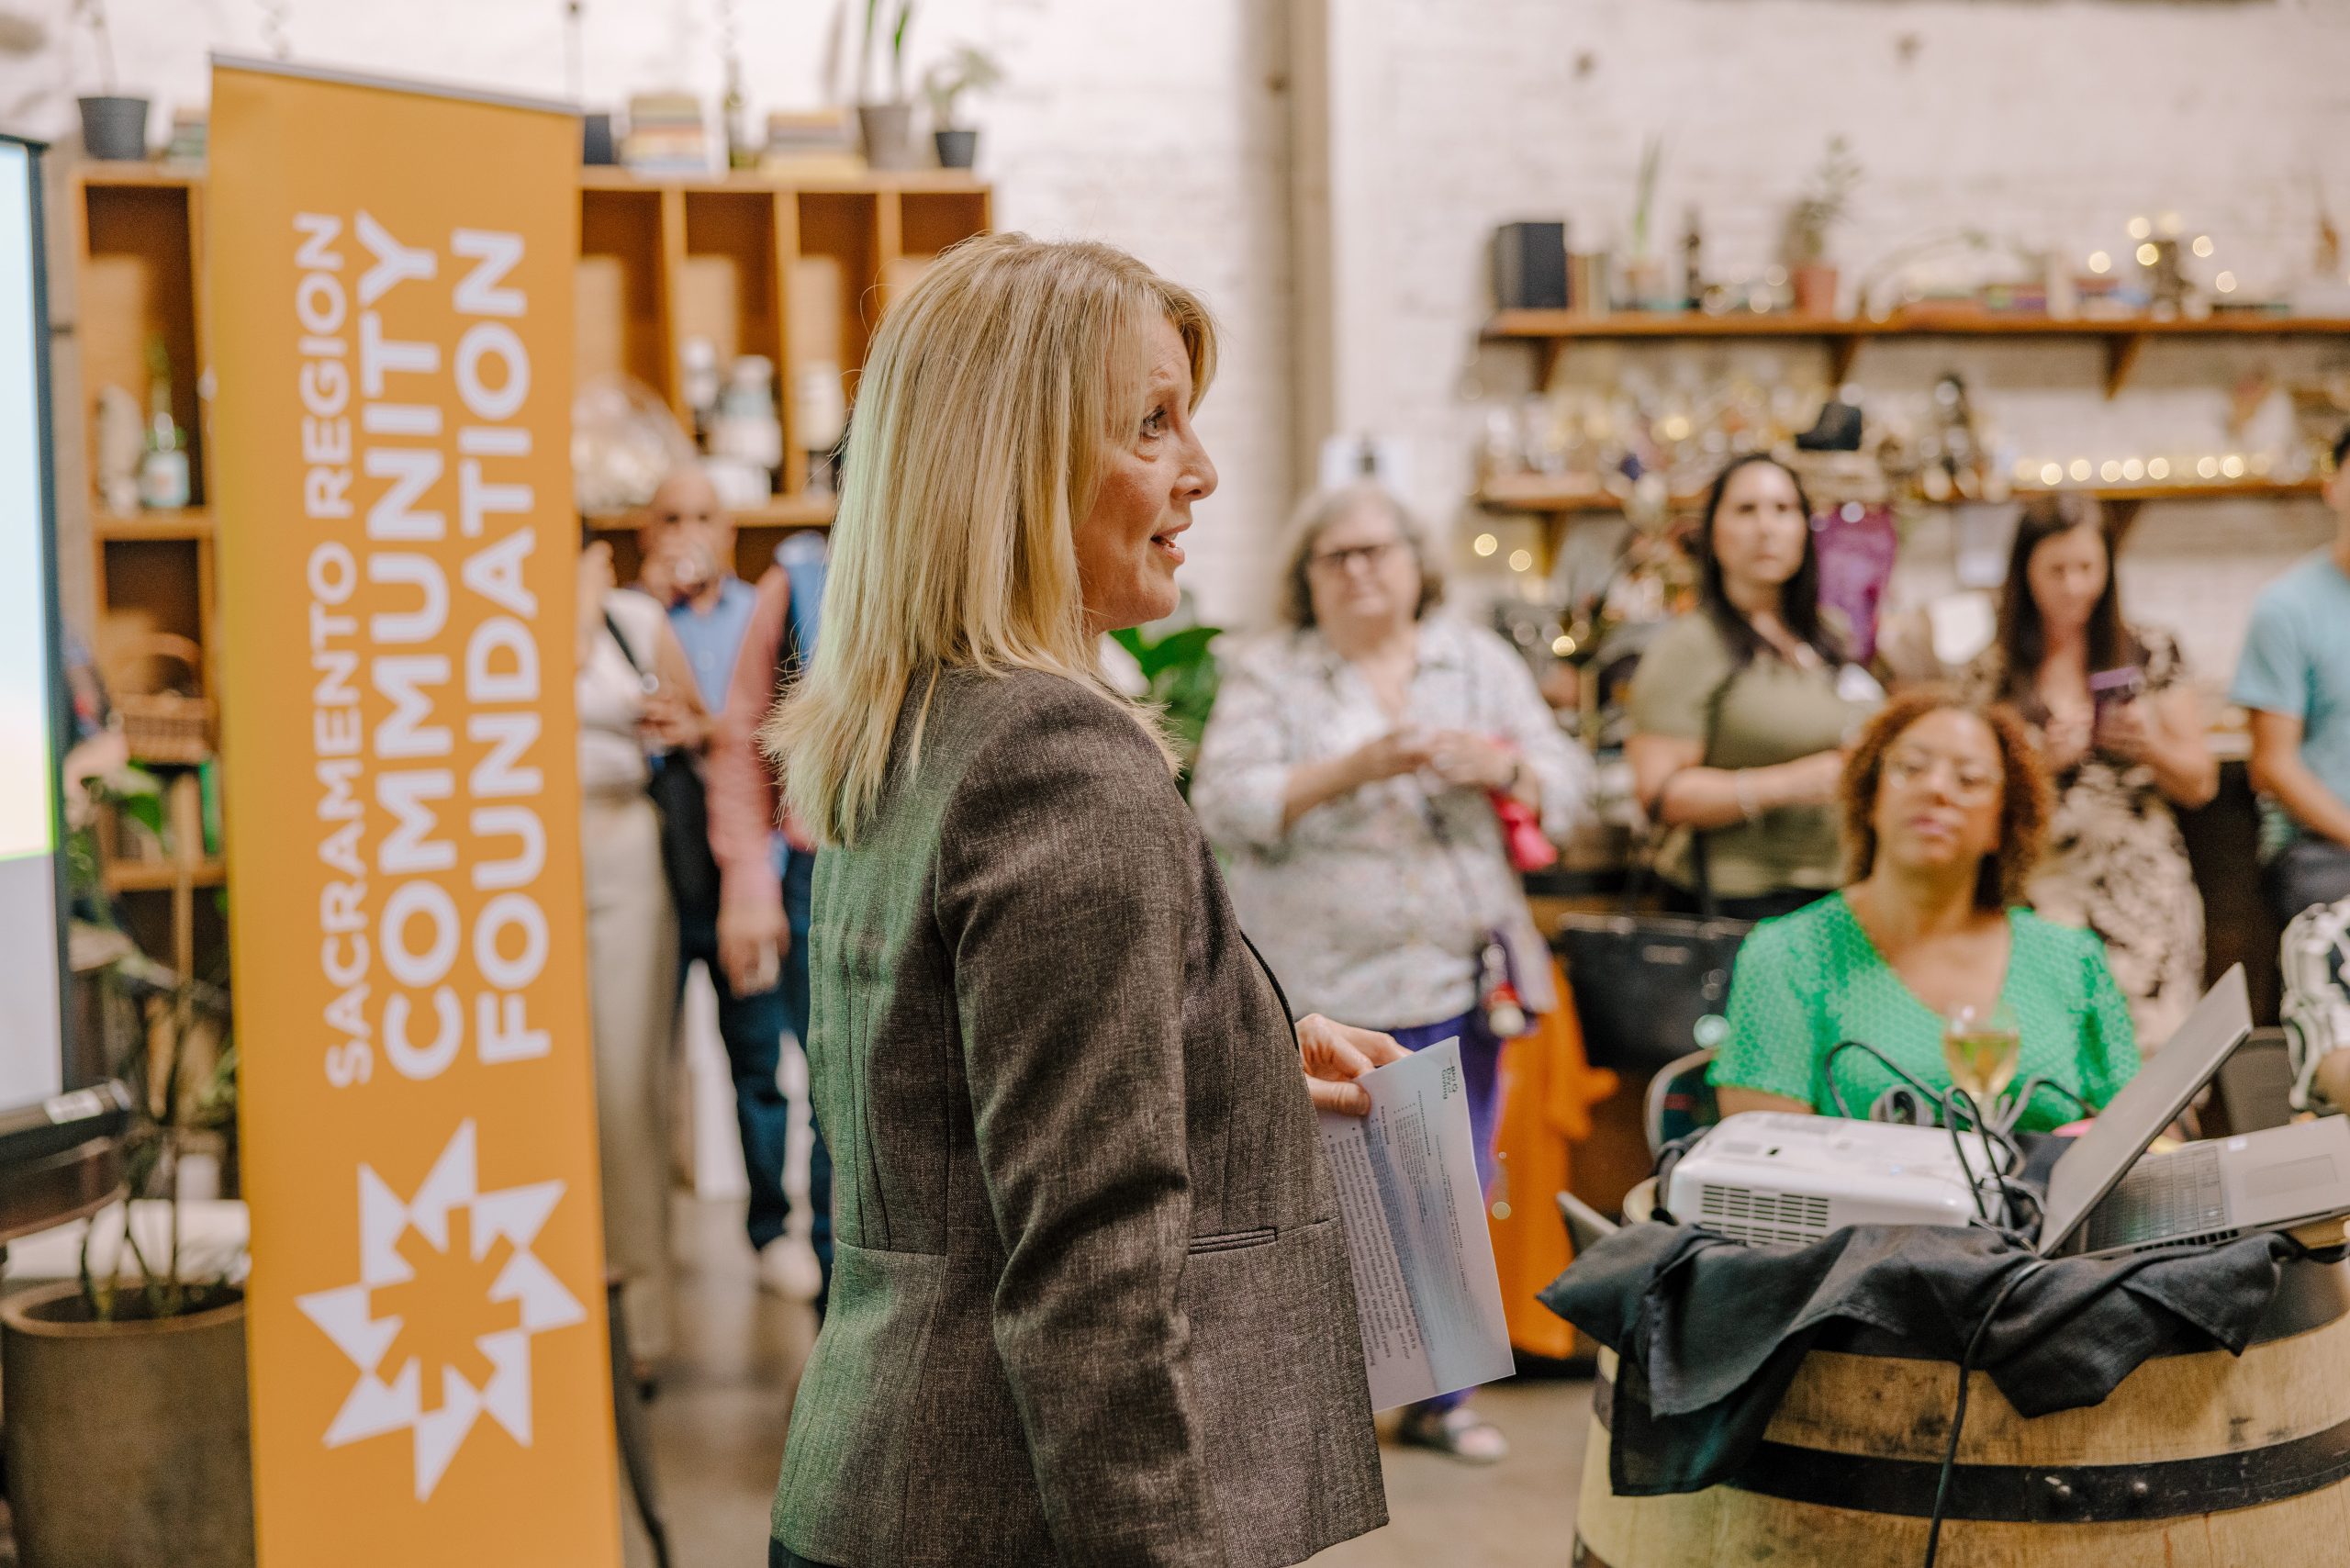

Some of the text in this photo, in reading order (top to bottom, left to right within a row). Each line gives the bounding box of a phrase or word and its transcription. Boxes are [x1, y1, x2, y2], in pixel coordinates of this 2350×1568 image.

[294, 214, 372, 1086] SACRAMENTO REGION
[356, 212, 462, 1079] COMMUNITY
[452, 229, 550, 1063] FOUNDATION
[1381, 1235, 1389, 1251] from
[1385, 1251, 1401, 1292] participating
